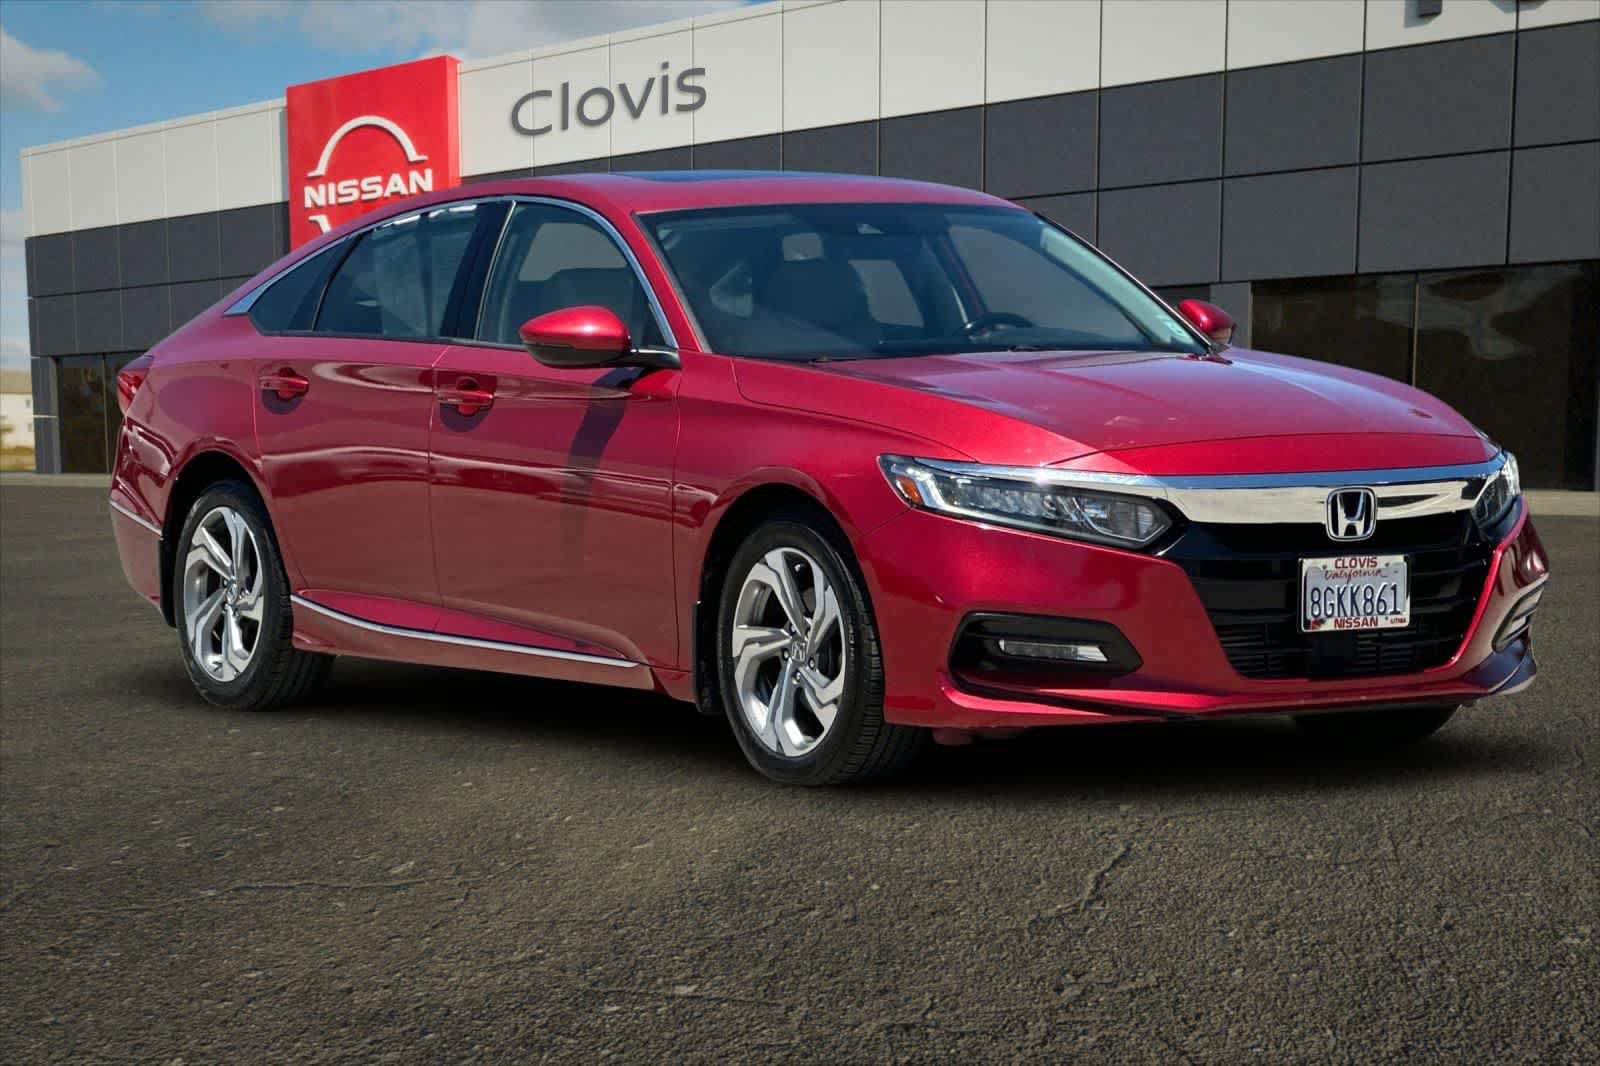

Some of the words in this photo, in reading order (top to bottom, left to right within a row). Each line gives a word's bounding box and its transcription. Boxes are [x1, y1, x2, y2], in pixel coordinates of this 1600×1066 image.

[511, 61, 707, 136] Clovis
[304, 168, 433, 208] NISSAN
[1334, 556, 1378, 569] CLOVIS
[1310, 583, 1401, 618] 8GKK861
[1334, 617, 1379, 629] NISSAN
